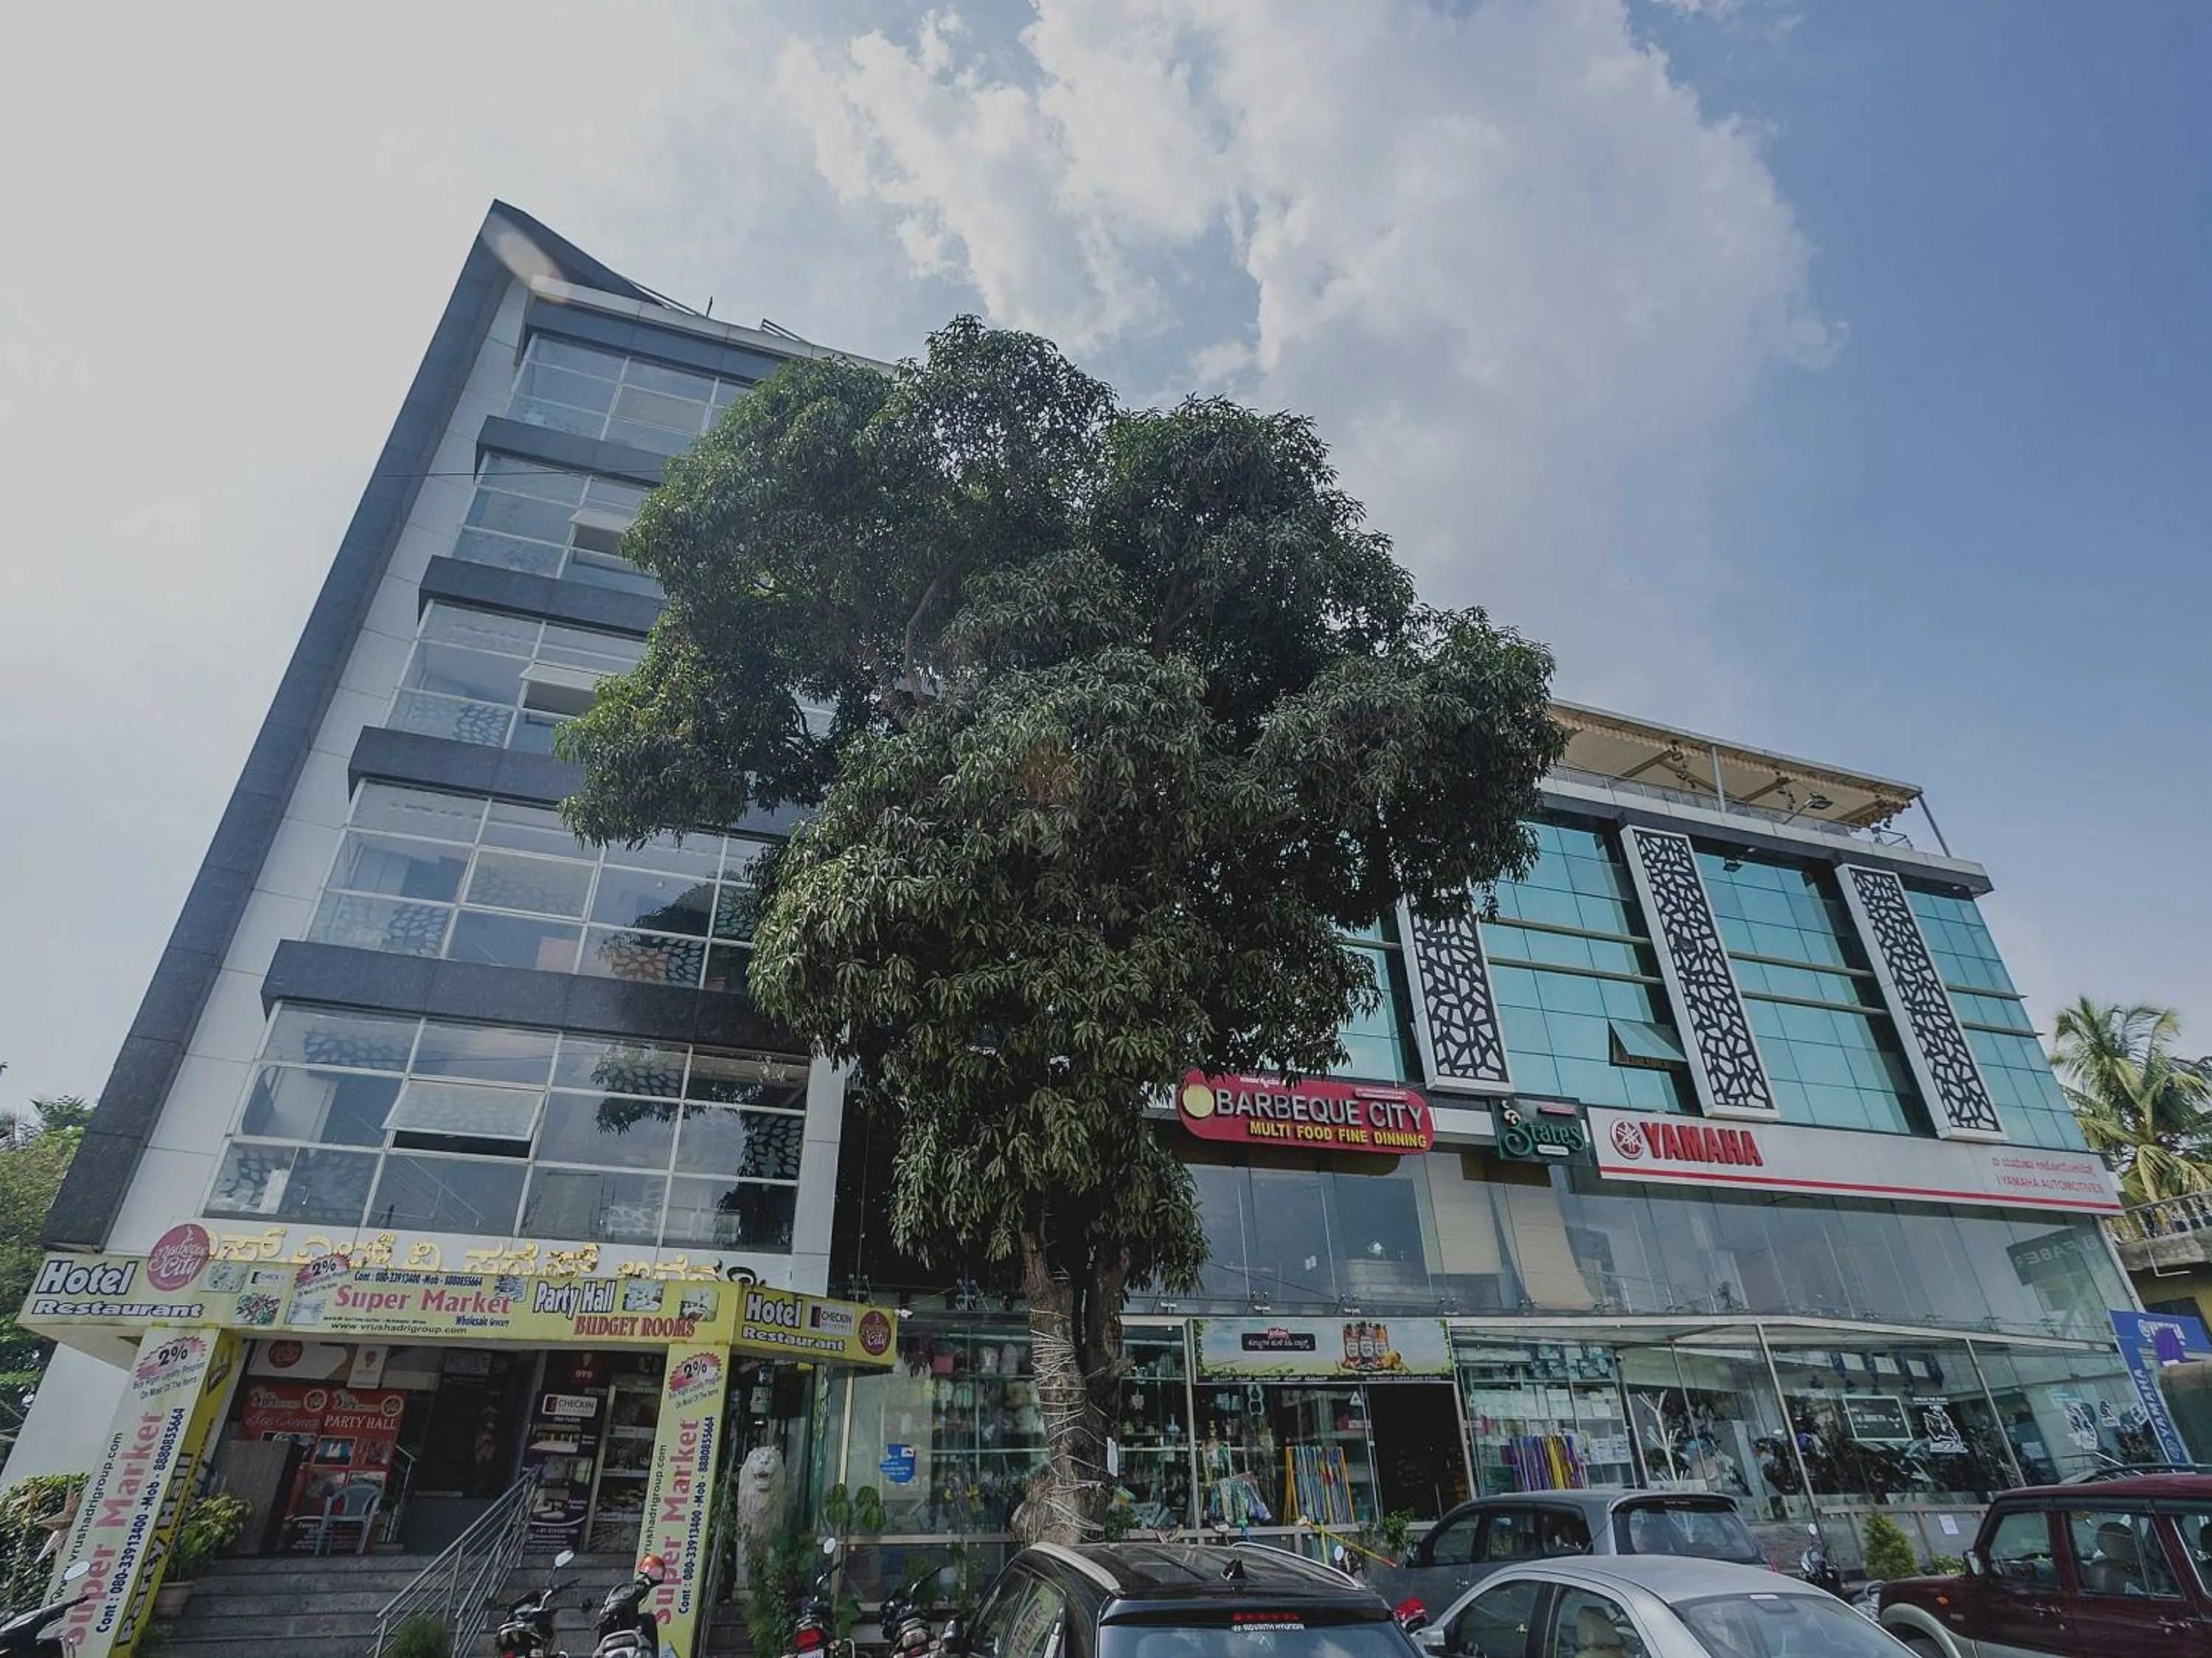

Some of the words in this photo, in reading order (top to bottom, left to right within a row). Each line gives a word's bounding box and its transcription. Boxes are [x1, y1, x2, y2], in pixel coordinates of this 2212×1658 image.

[1216, 1088, 1363, 1125] BARBEQUE
[1368, 1102, 1423, 1131] CITY
[1249, 1120, 1291, 1136] MULTI
[1296, 1126, 1333, 1141] FOOD
[1338, 1129, 1368, 1143] FINE
[1374, 1132, 1427, 1148] DINNING
[1639, 1121, 1764, 1167] YAMAHA
[35, 1260, 139, 1295] Hotel
[312, 1259, 337, 1277] 2%
[355, 1271, 372, 1282] Cont
[32, 1299, 206, 1318] Restaurant
[334, 1284, 411, 1312] Super
[420, 1288, 512, 1314] Market
[532, 1280, 580, 1321] Party
[579, 1280, 617, 1314] Hall
[744, 1291, 804, 1329] Hotel
[455, 1315, 488, 1327] Wholesale
[574, 1315, 639, 1336] BUDGET
[640, 1317, 696, 1338] ROOMS
[742, 1325, 846, 1351] Restaurant
[159, 1345, 188, 1367] 2%
[684, 1359, 707, 1380] 2%
[2133, 1368, 2174, 1438] YAMAHA
[324, 1415, 366, 1429] PARTY
[366, 1416, 398, 1431] HALL
[698, 1415, 715, 1474] 8880855664
[660, 1418, 700, 1523] Market
[156, 1452, 194, 1530] Hall
[61, 1544, 117, 1647] Super
[94, 1411, 165, 1530] Market
[95, 1604, 118, 1634] Cont
[110, 1513, 148, 1595] 080-33913400
[153, 1407, 186, 1472] 8880855664
[682, 1510, 702, 1581] 080-33913400
[654, 1536, 683, 1626] Super
[678, 1589, 692, 1614] Cont
